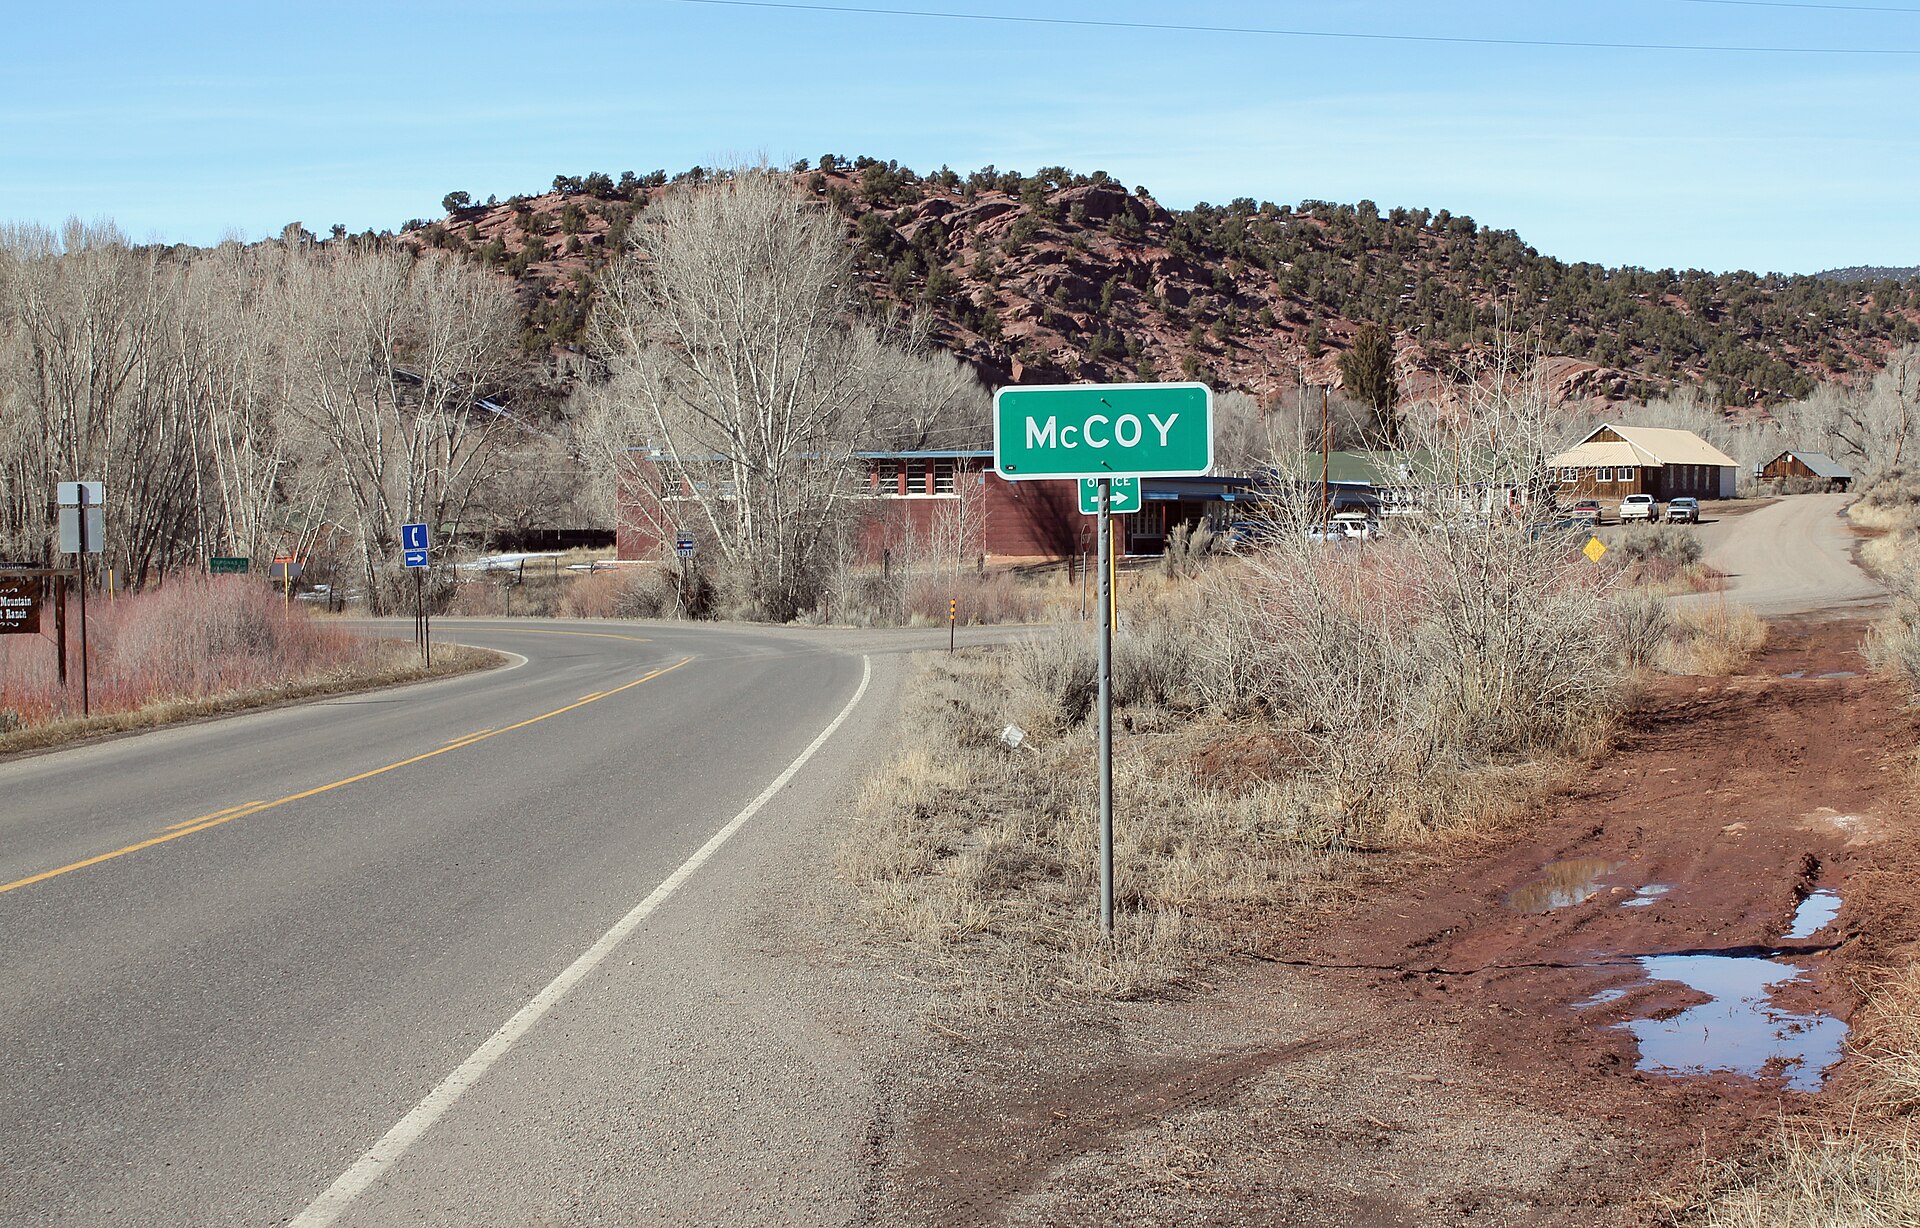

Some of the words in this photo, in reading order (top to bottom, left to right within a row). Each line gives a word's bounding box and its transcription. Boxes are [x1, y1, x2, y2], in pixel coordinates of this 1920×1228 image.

[1025, 413, 1180, 450] McCOY
[1087, 477, 1131, 487] OICE
[0, 596, 32, 606] Mountain
[6, 609, 27, 619] Ranch
